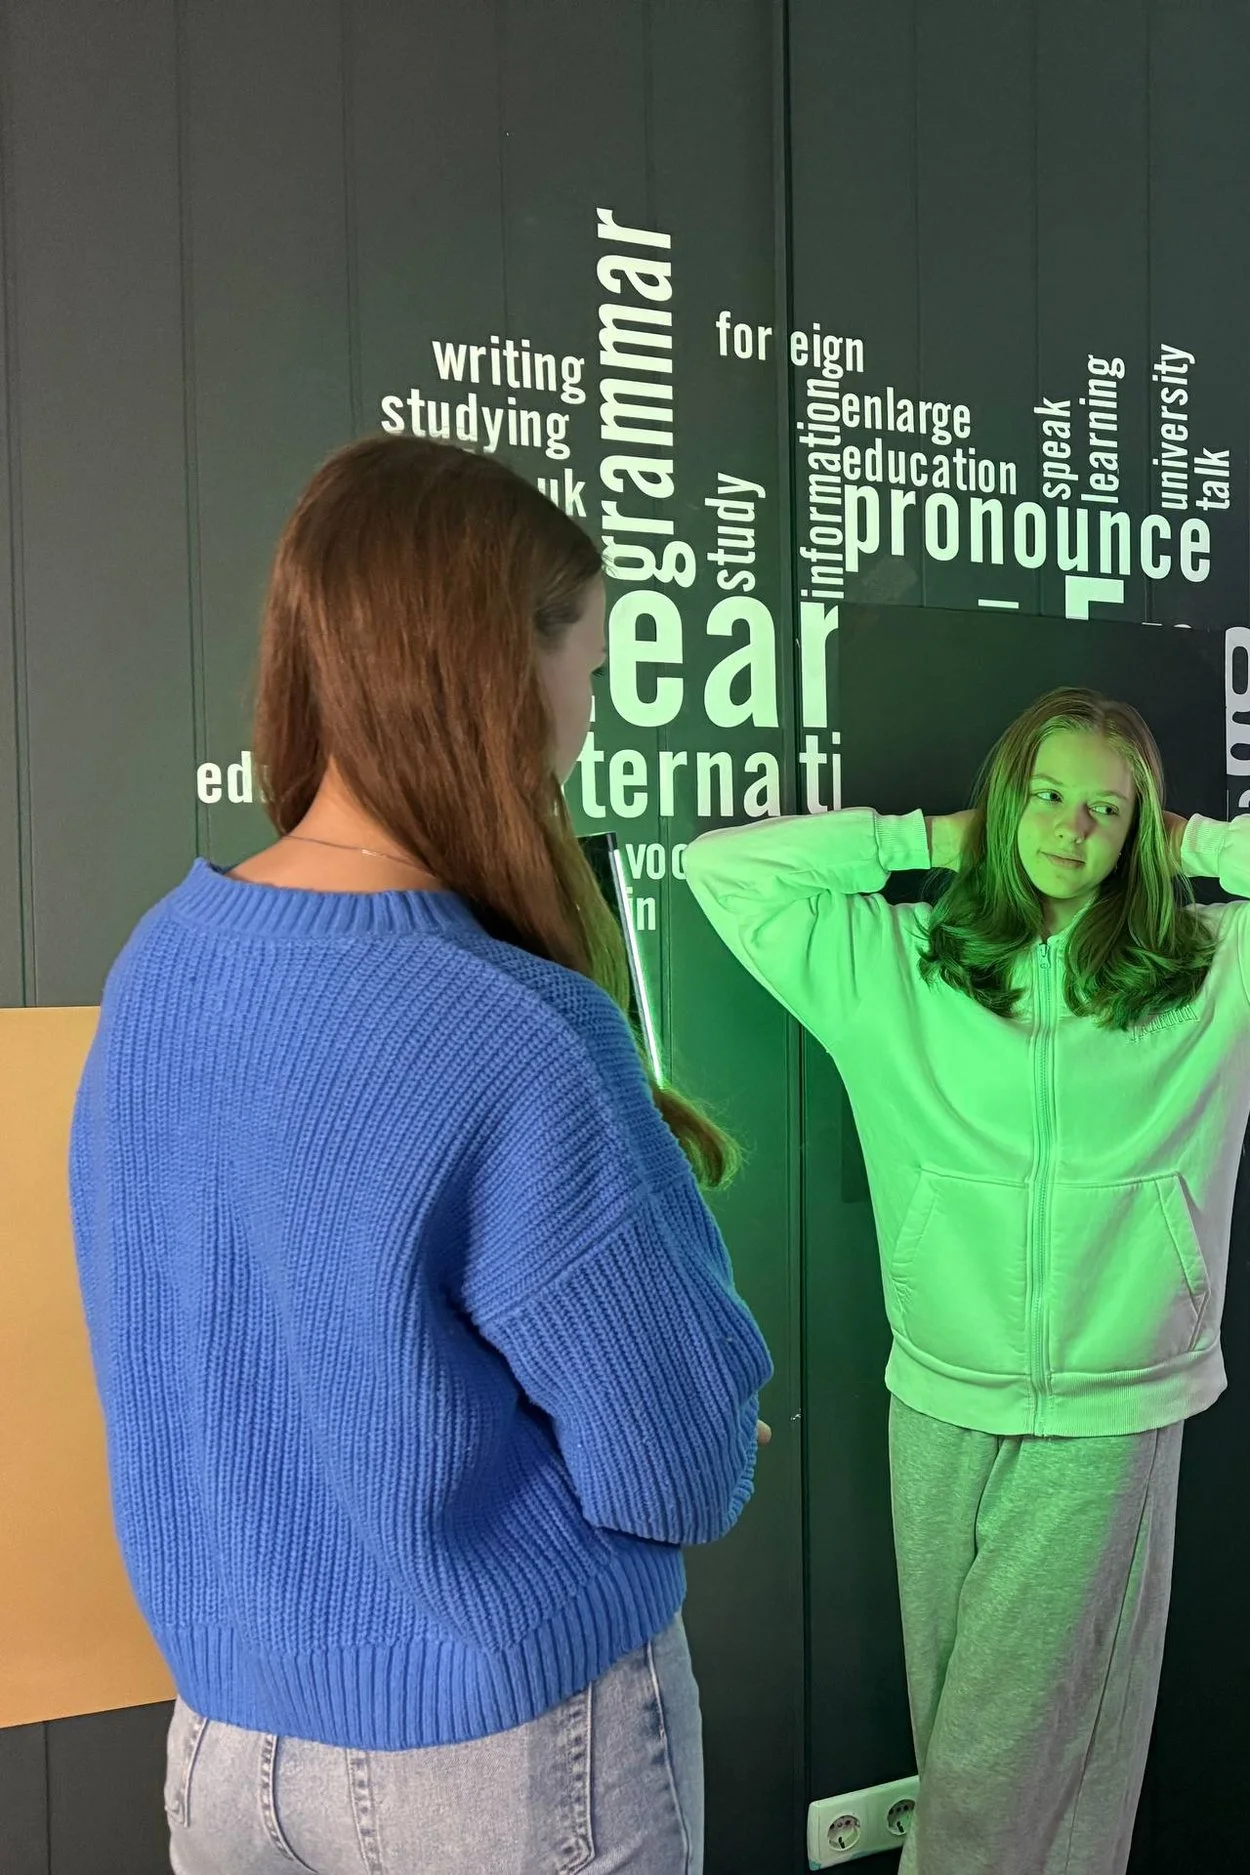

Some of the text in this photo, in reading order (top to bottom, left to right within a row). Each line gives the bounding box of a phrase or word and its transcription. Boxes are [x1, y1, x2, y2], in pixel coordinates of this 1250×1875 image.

[432, 335, 587, 405] writing
[597, 208, 696, 588] grammar
[842, 387, 971, 445] enlarge
[381, 388, 571, 460] studying
[842, 438, 1017, 495] education
[1034, 397, 1071, 500] speak
[1080, 355, 1125, 503] learning
[1153, 344, 1196, 509] university
[797, 378, 844, 599] information
[1194, 448, 1230, 511] talk
[705, 472, 766, 593] study
[845, 484, 1212, 583] pronounce
[605, 588, 841, 729] ear
[196, 750, 254, 805] ed
[574, 730, 842, 820] ternati
